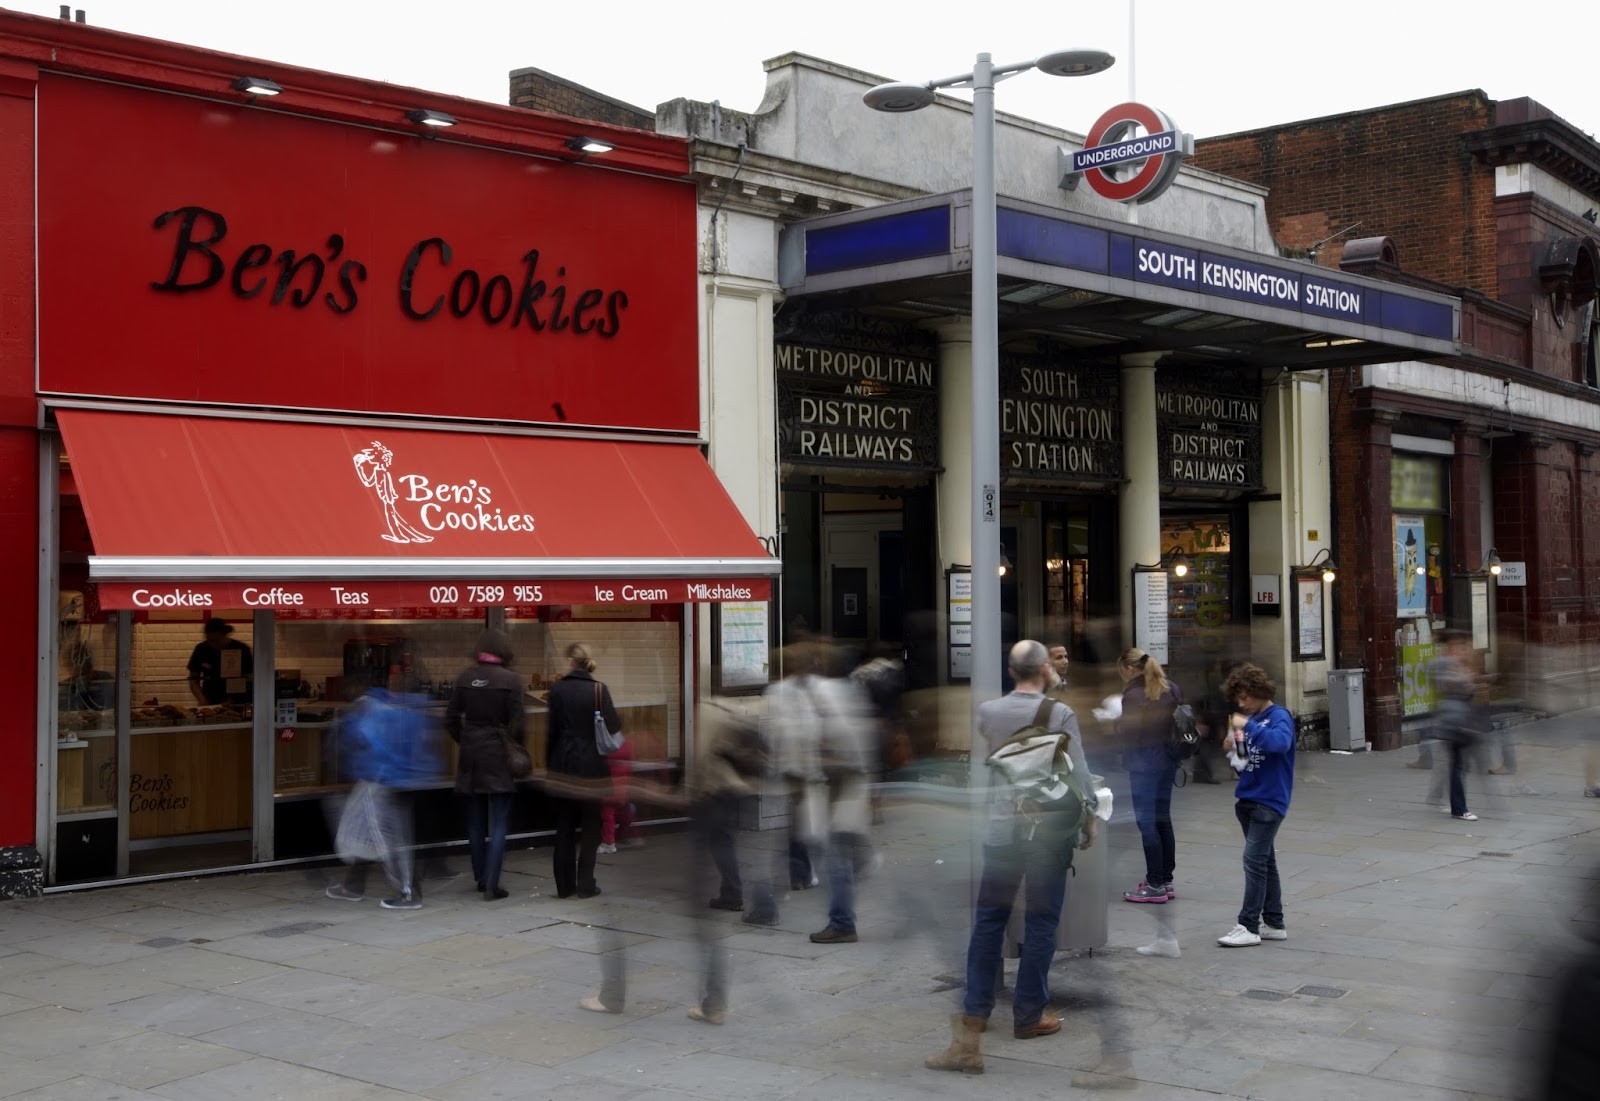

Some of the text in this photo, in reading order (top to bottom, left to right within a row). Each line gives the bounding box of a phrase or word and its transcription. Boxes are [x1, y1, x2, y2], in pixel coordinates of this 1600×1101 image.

[1077, 136, 1172, 166] UNDERGROUND
[151, 206, 629, 338] Ben's Cookies
[1138, 248, 1360, 314] SOUTH KENSINGTON STATION
[776, 344, 933, 386] METROPOLITAN
[844, 384, 872, 397] AND
[1020, 367, 1078, 399] SOUTH
[800, 398, 912, 431] DISTRICT
[1002, 398, 1112, 441] ENSINGTON
[1157, 392, 1258, 422] METROPOLITAN
[1200, 422, 1218, 432] AND
[800, 430, 913, 461] RAILWAYS
[1012, 441, 1093, 472] STATION
[1173, 434, 1245, 458] DISTRICT
[1173, 459, 1245, 483] RAILWAYS
[398, 474, 492, 505] Ben's
[420, 502, 535, 532] Cookies
[132, 583, 752, 607] Cookies Coffee Teas 020 7589 9155 Ice Cream Milkshakes
[1257, 591, 1274, 602] LFB
[129, 773, 173, 793] Ben's
[129, 792, 189, 814] Cookies
